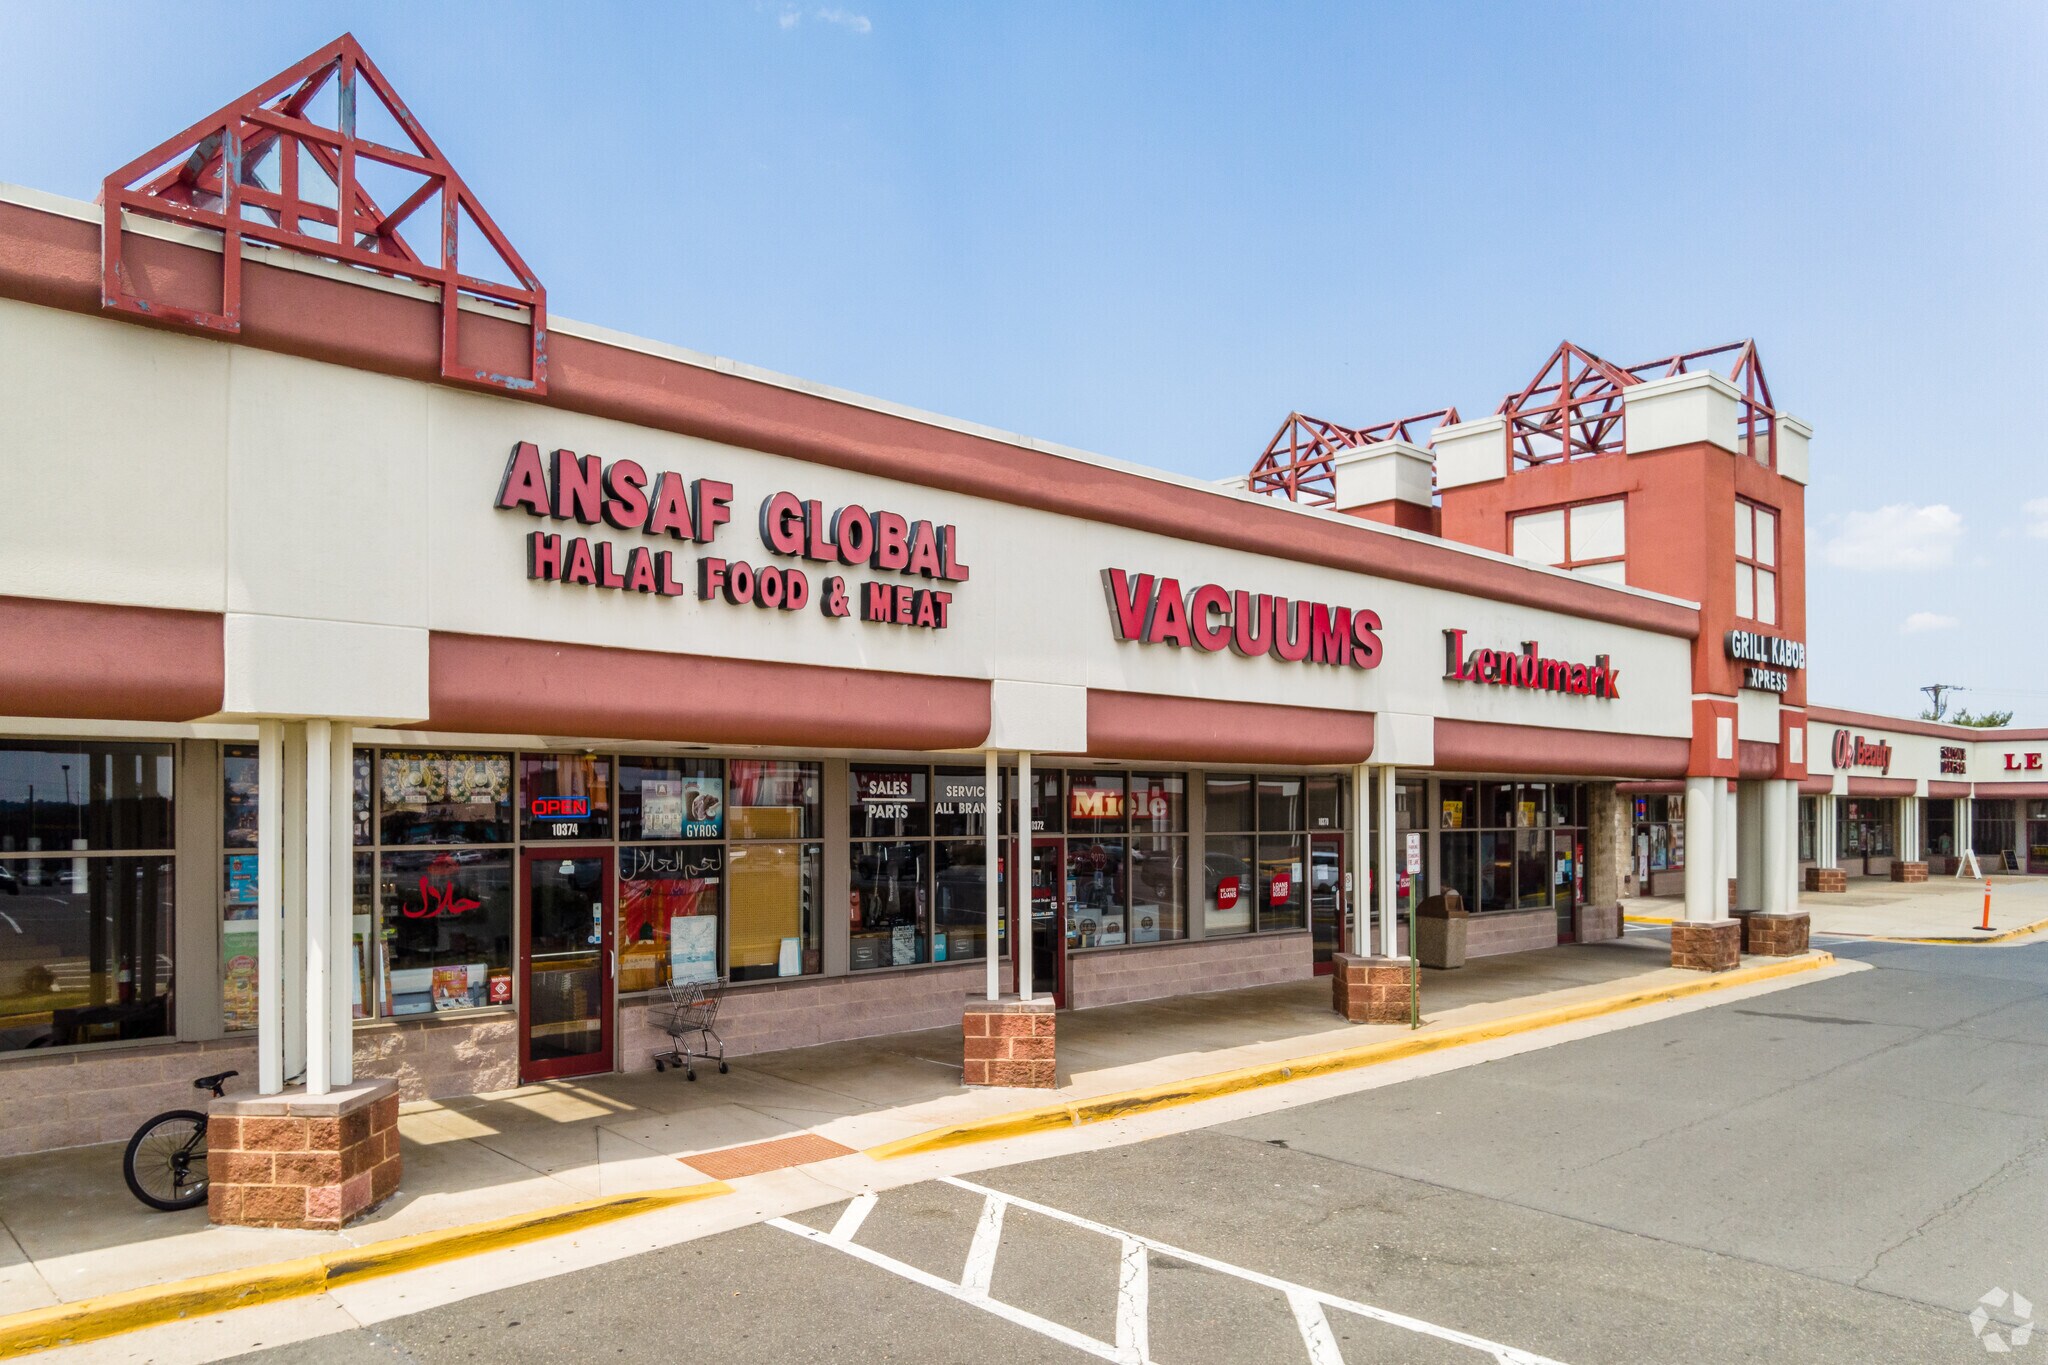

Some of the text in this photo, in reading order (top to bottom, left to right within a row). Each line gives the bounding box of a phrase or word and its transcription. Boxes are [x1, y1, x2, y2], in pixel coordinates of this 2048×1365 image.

[494, 441, 969, 582] ANSAF GLOBAL
[527, 531, 953, 629] HALAL FOOD & MEAT
[1100, 567, 1383, 671] VACUUMS
[1442, 627, 1620, 700] Lendmark
[1727, 629, 1805, 670] GRILL KABOB
[1748, 667, 1788, 692] XPRESS
[1855, 735, 1892, 776] Beauty
[869, 780, 908, 796] SALES
[946, 785, 987, 798] SERVIC
[532, 799, 588, 815] OPEN
[868, 804, 909, 819] PARTS
[935, 802, 1002, 815] ALL BRANS
[1073, 790, 1168, 818] Miele
[552, 823, 579, 837] 10374
[686, 824, 718, 838] GYROS
[617, 847, 722, 881] لحم الحلال
[403, 875, 480, 919] حلال
